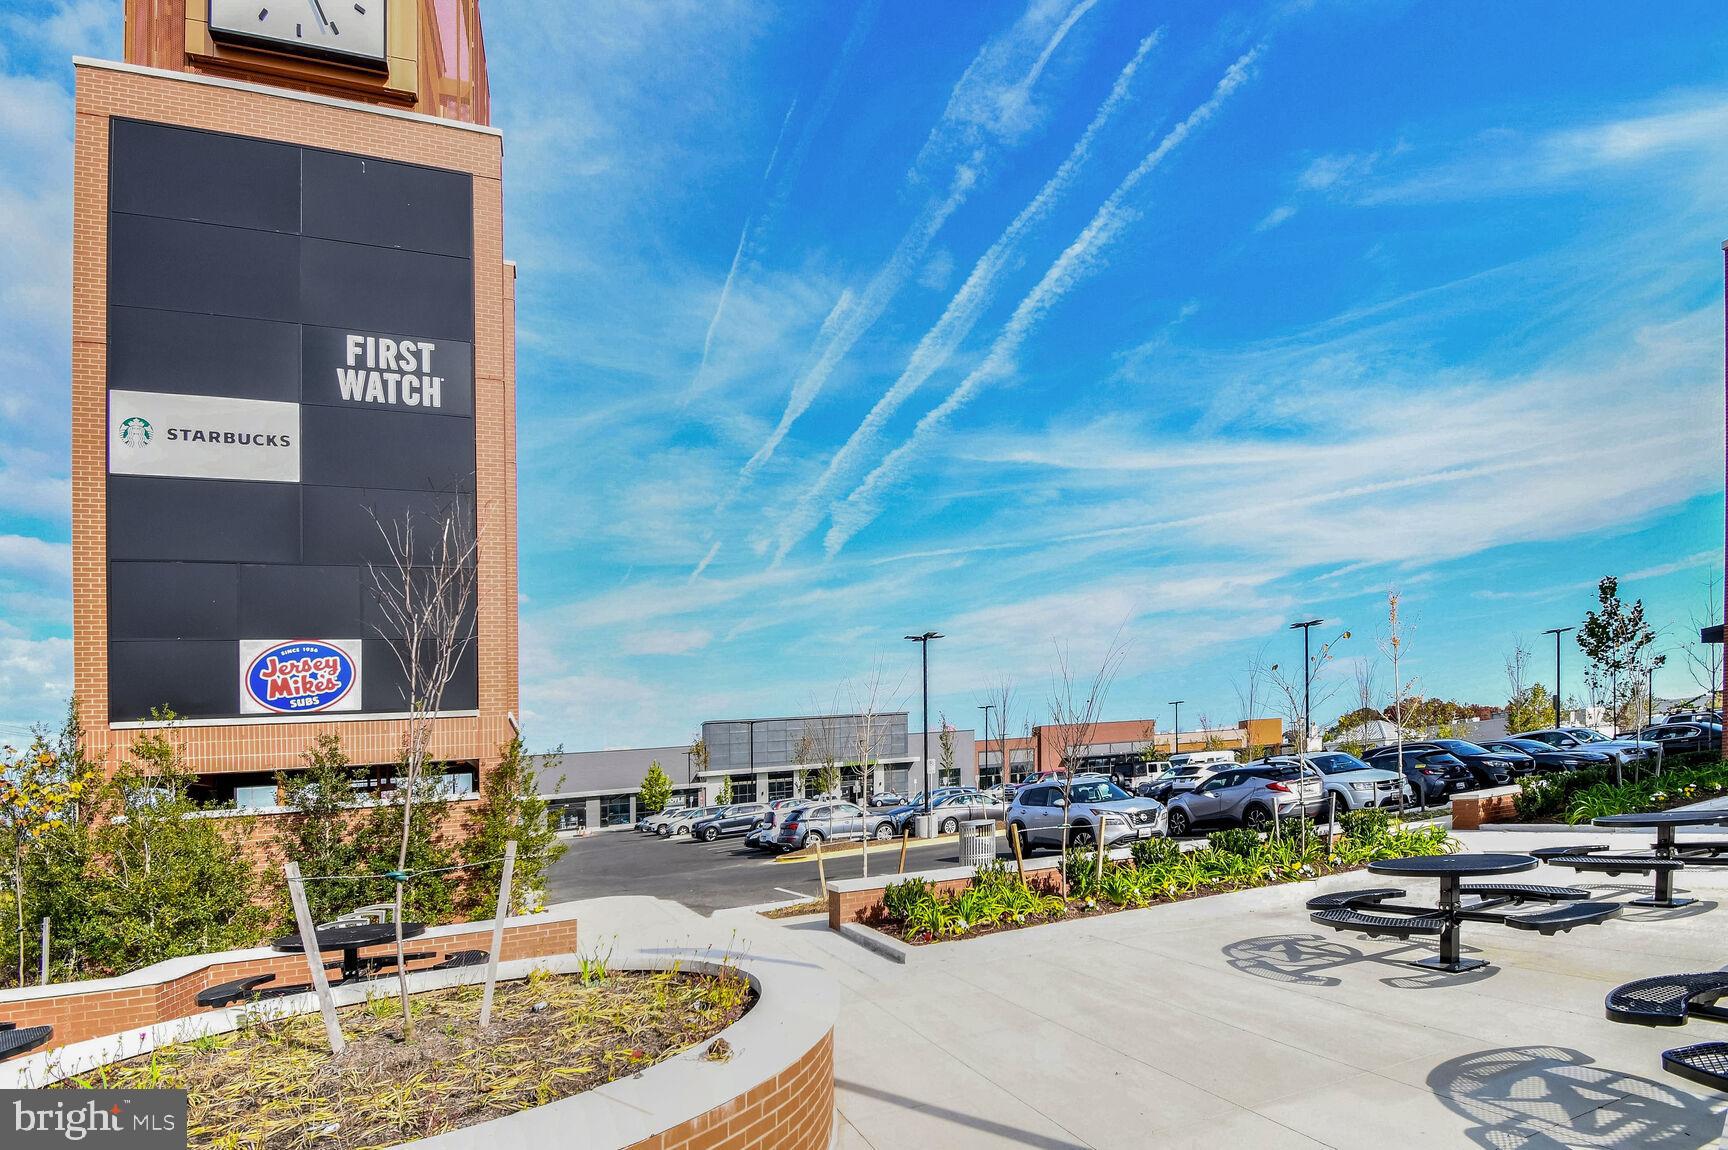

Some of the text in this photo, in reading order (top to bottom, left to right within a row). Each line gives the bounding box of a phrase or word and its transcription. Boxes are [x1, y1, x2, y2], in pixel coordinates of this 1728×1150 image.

[346, 334, 435, 374] FIRST
[336, 368, 441, 408] WATCH
[167, 428, 291, 447] STARBUCKS
[280, 647, 300, 656] SINCE
[261, 657, 340, 678] Jersey
[268, 674, 341, 699] Mike's
[289, 696, 320, 708] SUBS
